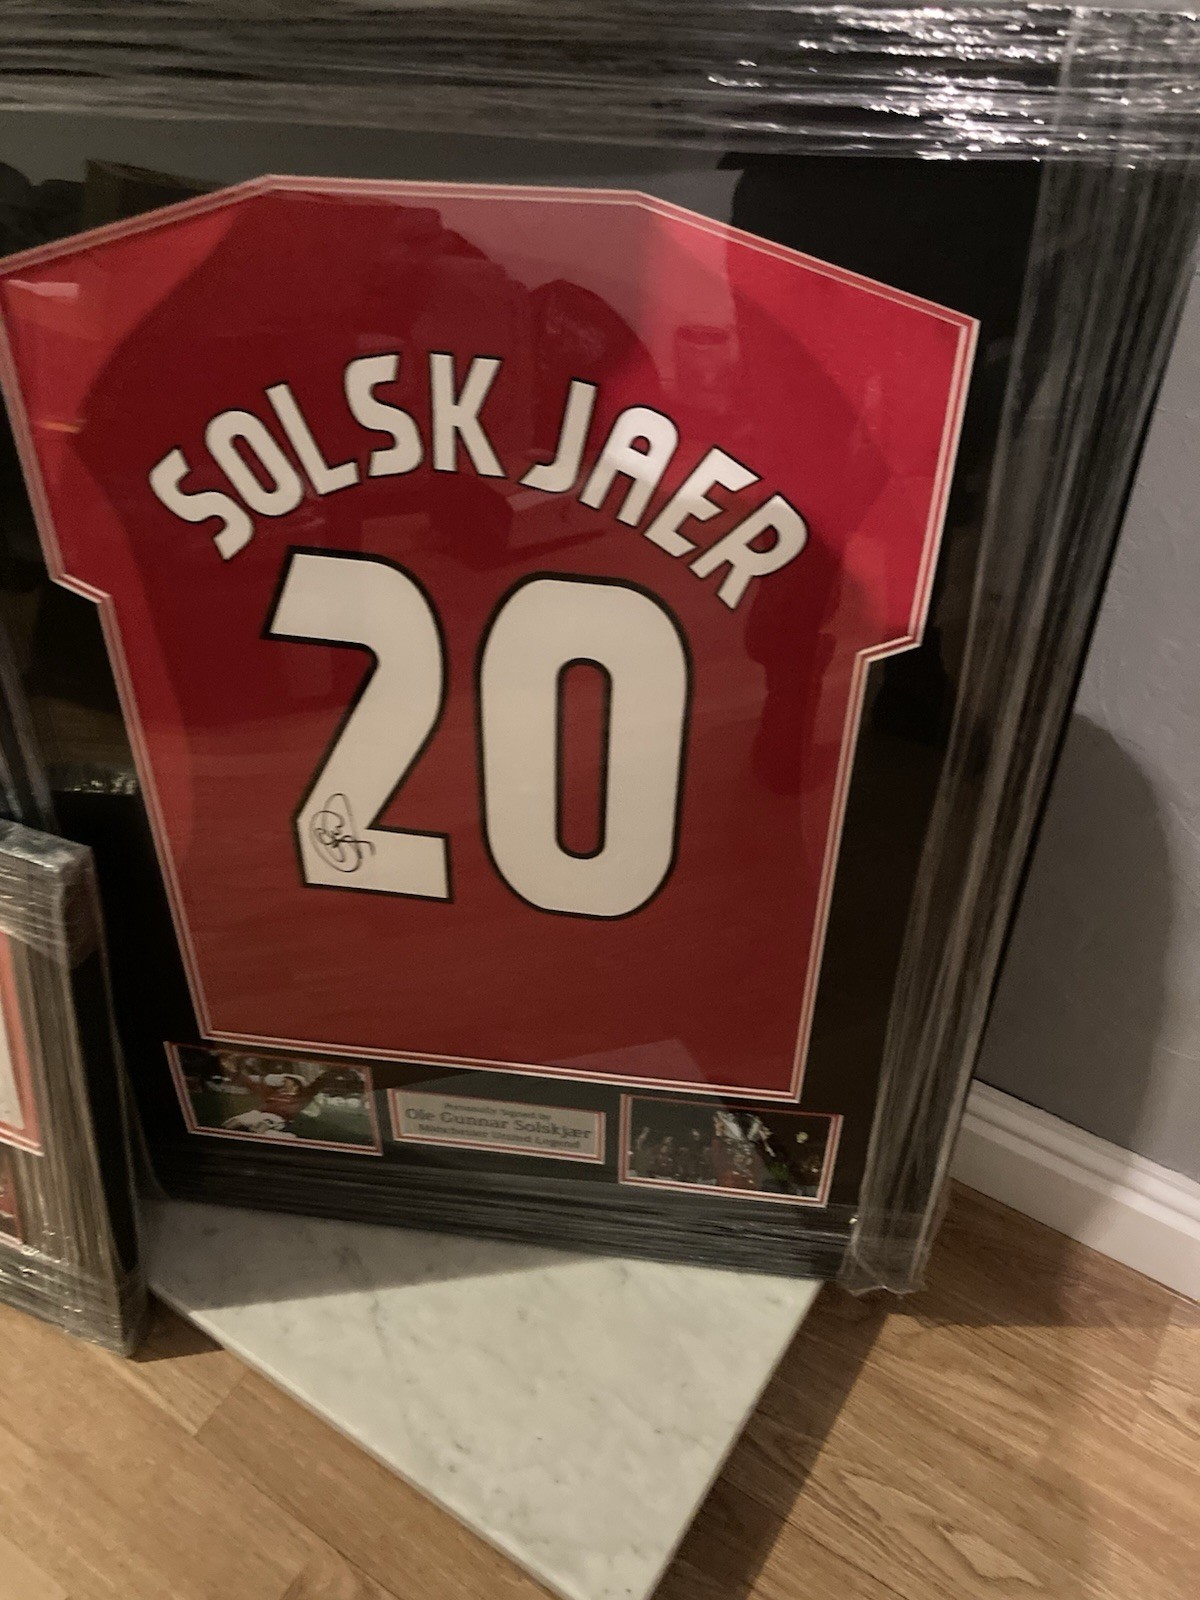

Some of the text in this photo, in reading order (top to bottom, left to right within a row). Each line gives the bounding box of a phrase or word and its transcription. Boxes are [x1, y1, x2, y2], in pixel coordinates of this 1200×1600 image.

[261, 545, 693, 920] 20
[405, 1108, 436, 1121] Ole
[440, 1111, 509, 1129] Gunnar
